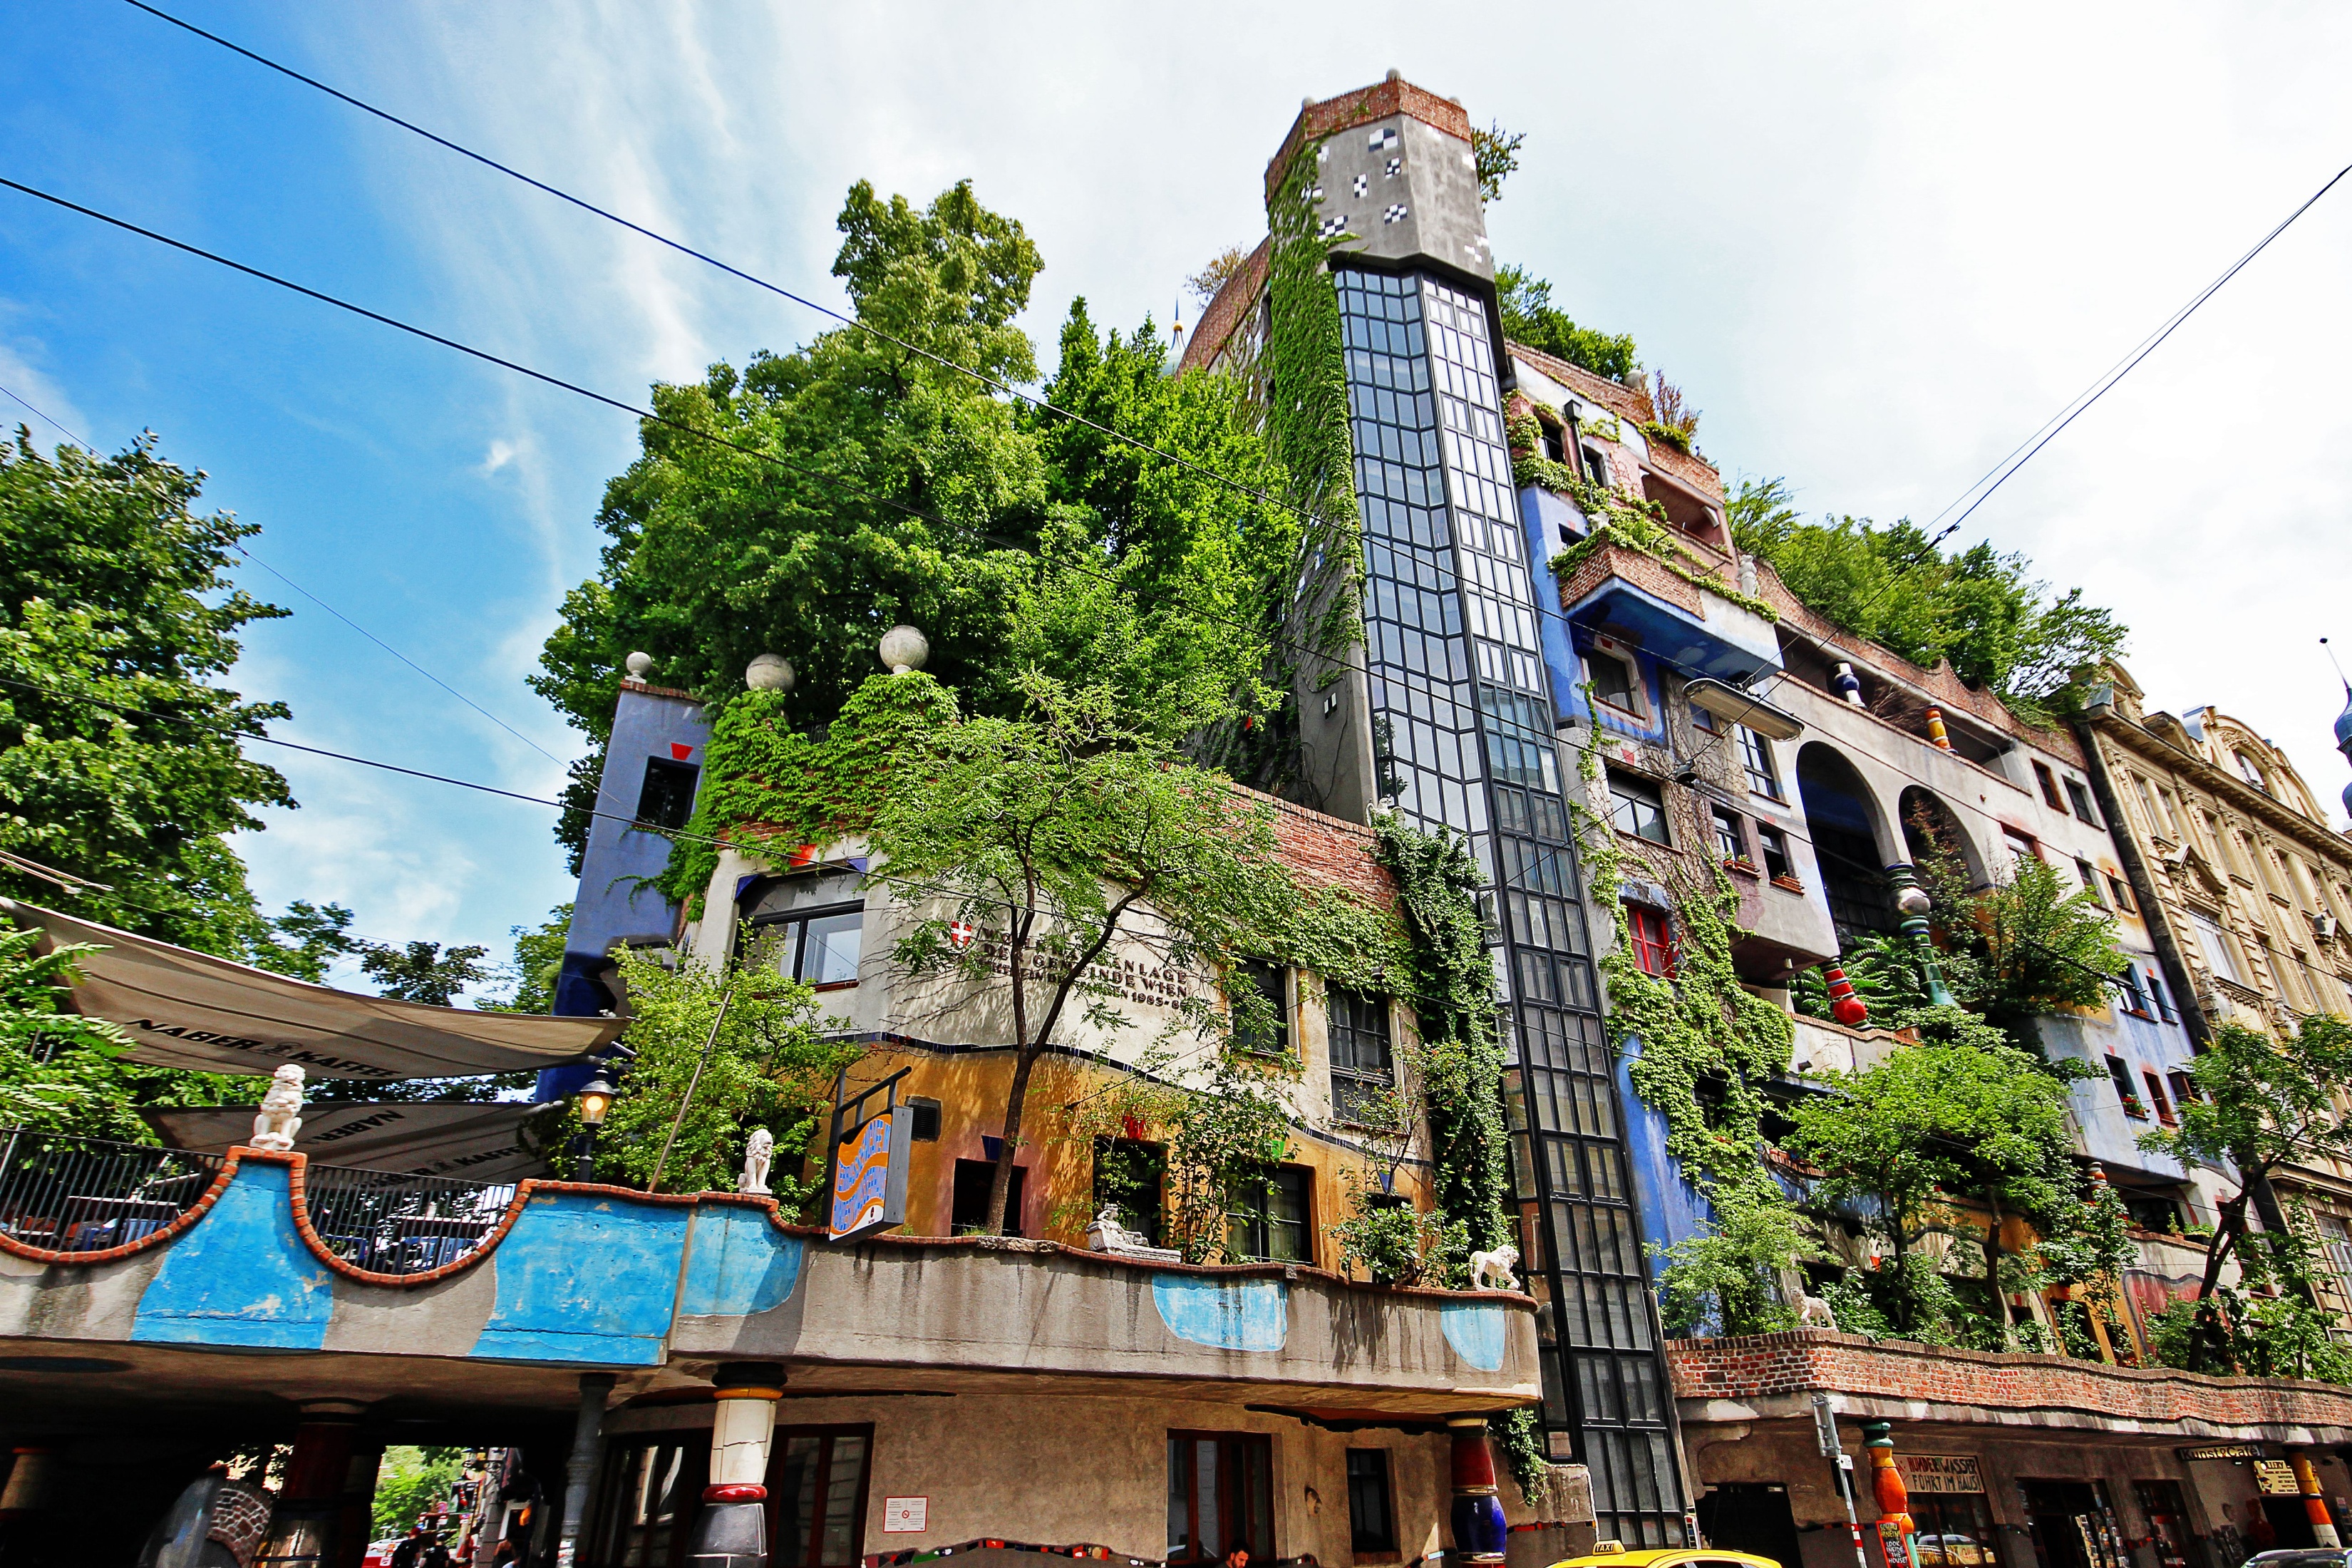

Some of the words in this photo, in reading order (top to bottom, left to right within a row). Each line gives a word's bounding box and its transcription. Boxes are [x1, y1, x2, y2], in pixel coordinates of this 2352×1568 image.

[1141, 976, 1187, 997] WIEN
[125, 1018, 264, 1051] NABER
[286, 1050, 402, 1078] KAFFEE
[319, 1109, 406, 1142] NABER
[453, 1145, 523, 1166] KAFFE
[1907, 1456, 1978, 1475] HUNDERTWASSER
[1944, 1475, 1956, 1491] IM
[1957, 1475, 1982, 1492] HAUS!
[1596, 1544, 1614, 1552] TAXI
